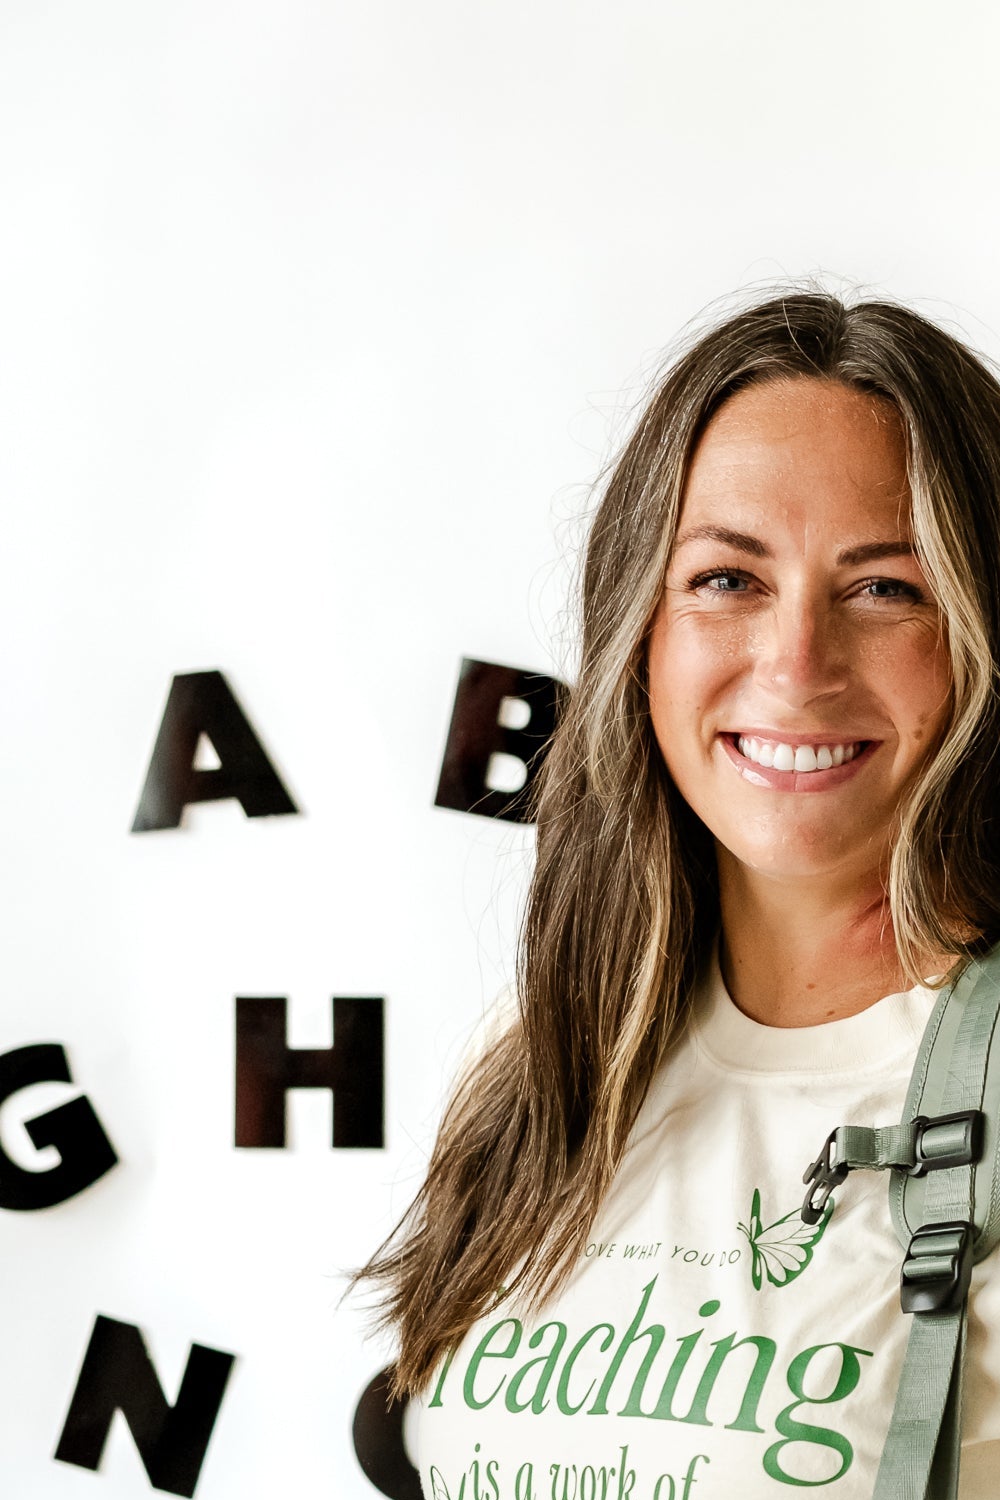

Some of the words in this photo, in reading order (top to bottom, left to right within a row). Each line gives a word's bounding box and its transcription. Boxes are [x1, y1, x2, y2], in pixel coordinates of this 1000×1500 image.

[131, 669, 299, 833] A
[433, 656, 574, 825] B
[0, 1042, 119, 1212] G
[234, 996, 385, 1149] H
[578, 1243, 616, 1259] OVE
[623, 1242, 662, 1260] WHAT
[670, 1245, 715, 1267] YOU
[718, 1249, 742, 1267] DO
[53, 1314, 236, 1500] N
